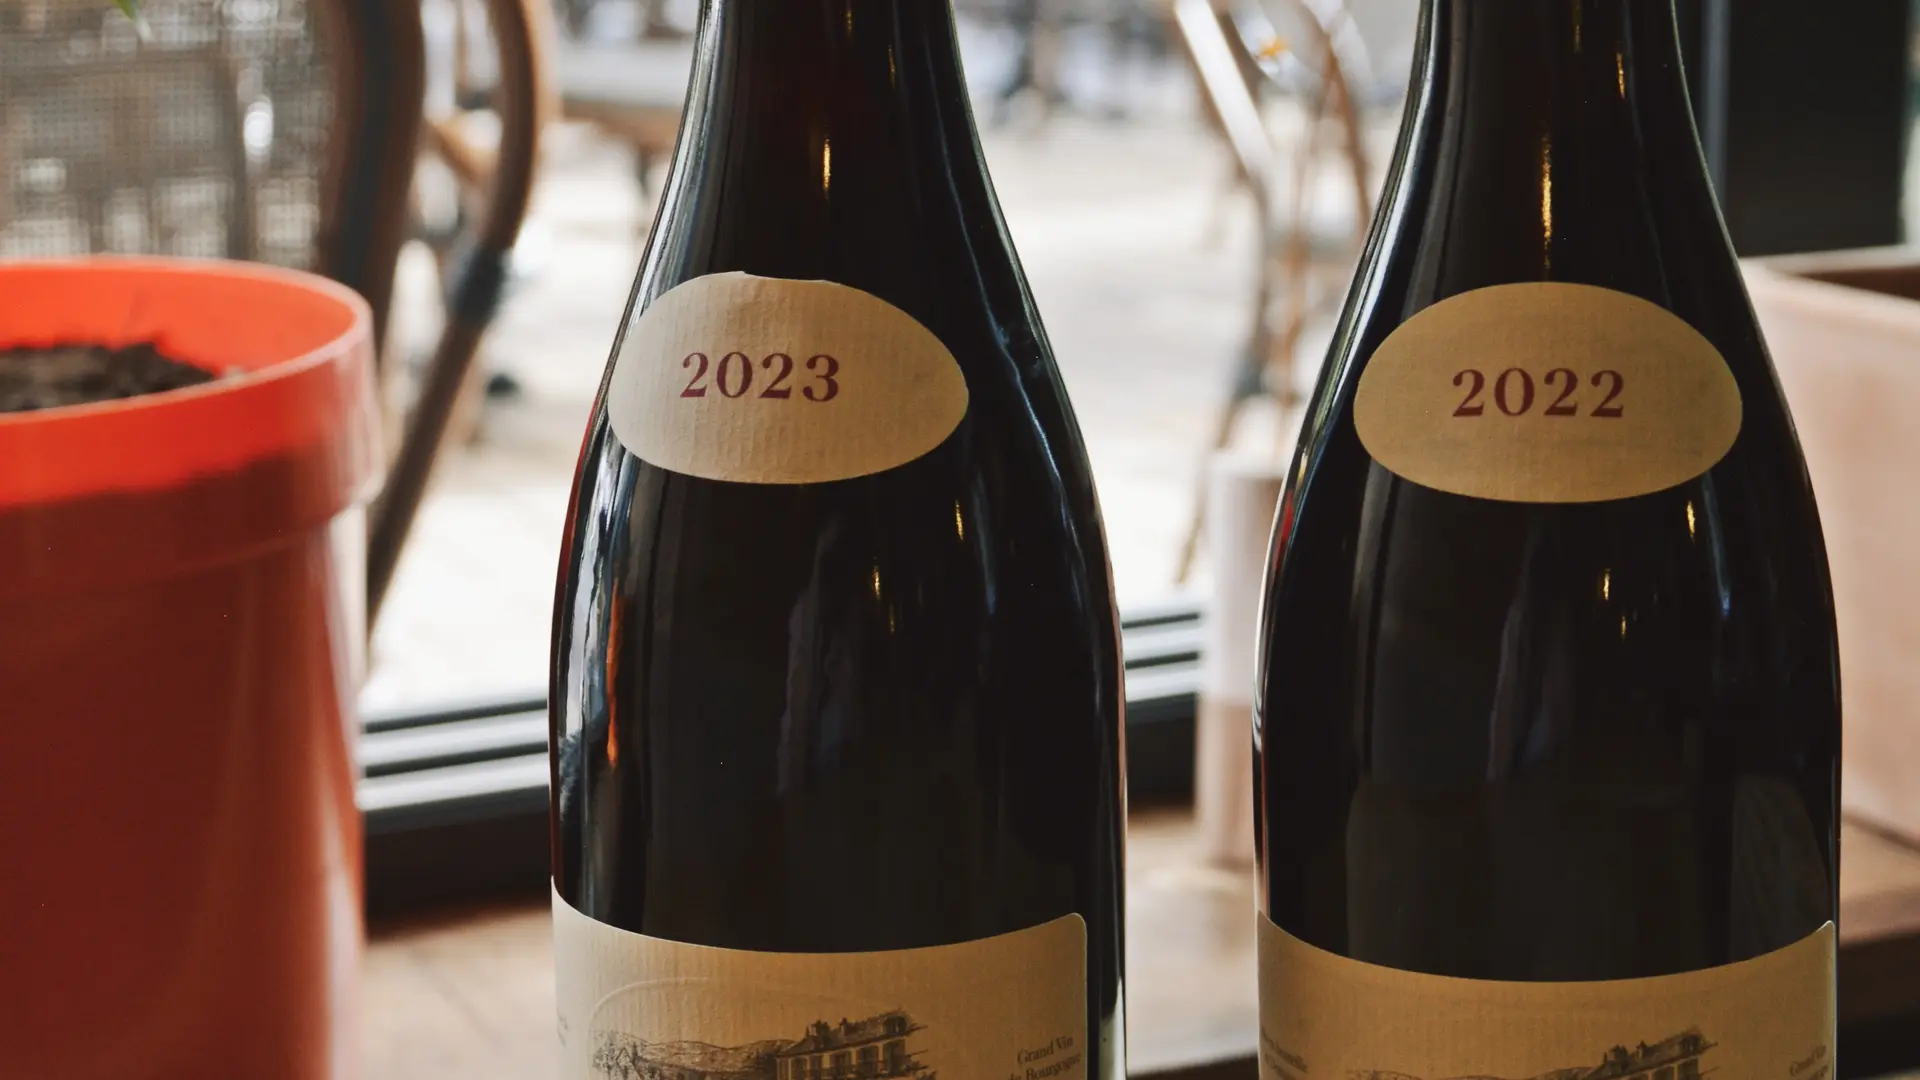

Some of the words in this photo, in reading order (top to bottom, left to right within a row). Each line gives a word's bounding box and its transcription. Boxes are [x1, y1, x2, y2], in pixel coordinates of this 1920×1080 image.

[679, 352, 840, 402] 2023
[1452, 367, 1625, 418] 2022
[1017, 1040, 1054, 1065] Grand
[1055, 1036, 1074, 1050] Vin
[1026, 1053, 1082, 1080] Bourgogne
